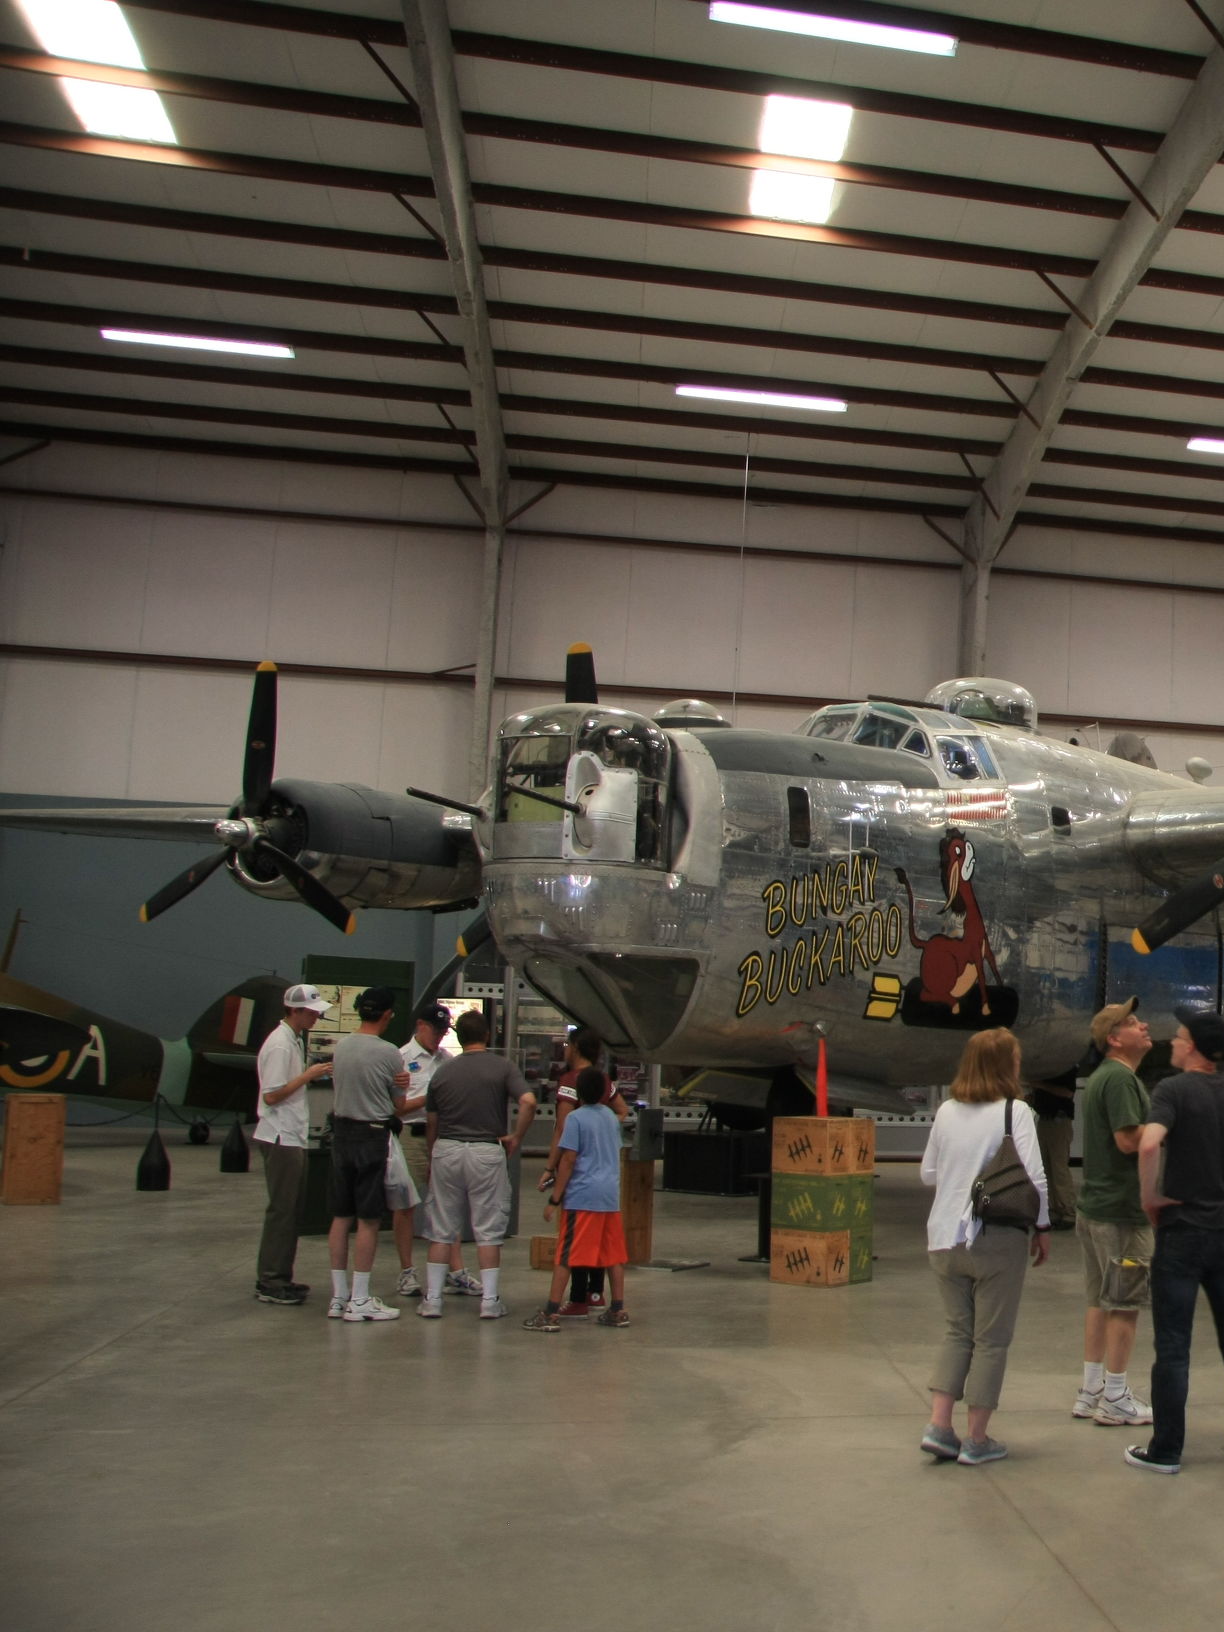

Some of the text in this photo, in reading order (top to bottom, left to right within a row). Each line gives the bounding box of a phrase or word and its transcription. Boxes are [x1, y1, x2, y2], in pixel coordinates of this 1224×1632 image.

[762, 854, 879, 938] BUNGAY
[737, 903, 902, 1017] BUCKAROO
[66, 1024, 107, 1086] A
